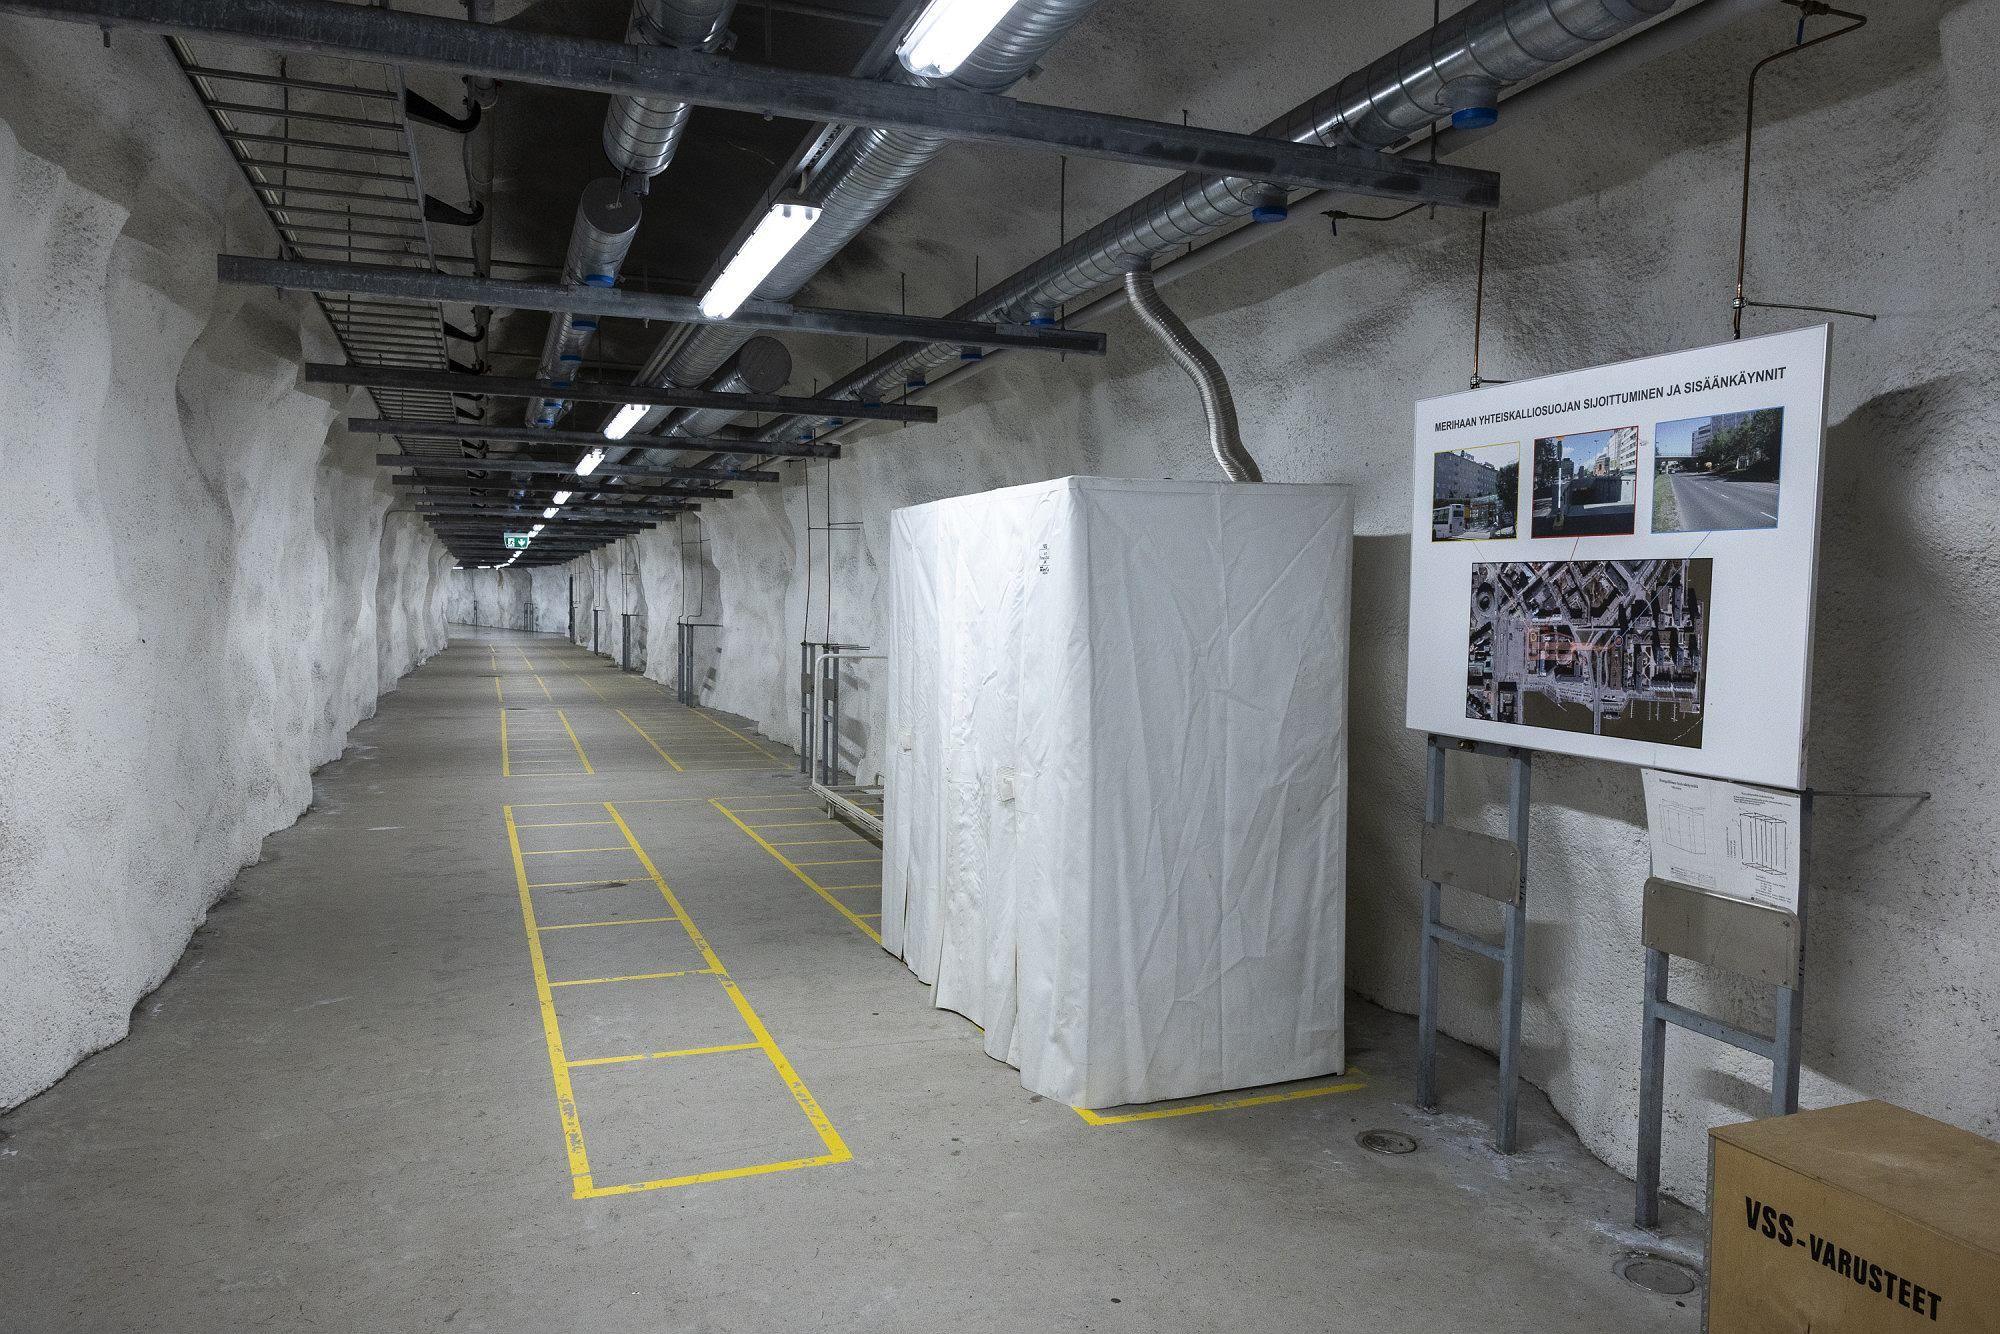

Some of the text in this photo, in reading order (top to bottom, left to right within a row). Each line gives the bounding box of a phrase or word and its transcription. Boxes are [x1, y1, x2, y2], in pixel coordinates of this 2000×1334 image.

[1434, 366, 1787, 432] MERIHAAN YHTEISKALLIOSUOJAN SIJOITTUMINEN JA SISÄÄNKÄYNNIT
[1745, 1195, 1943, 1322] VSS-VARUSTEET
